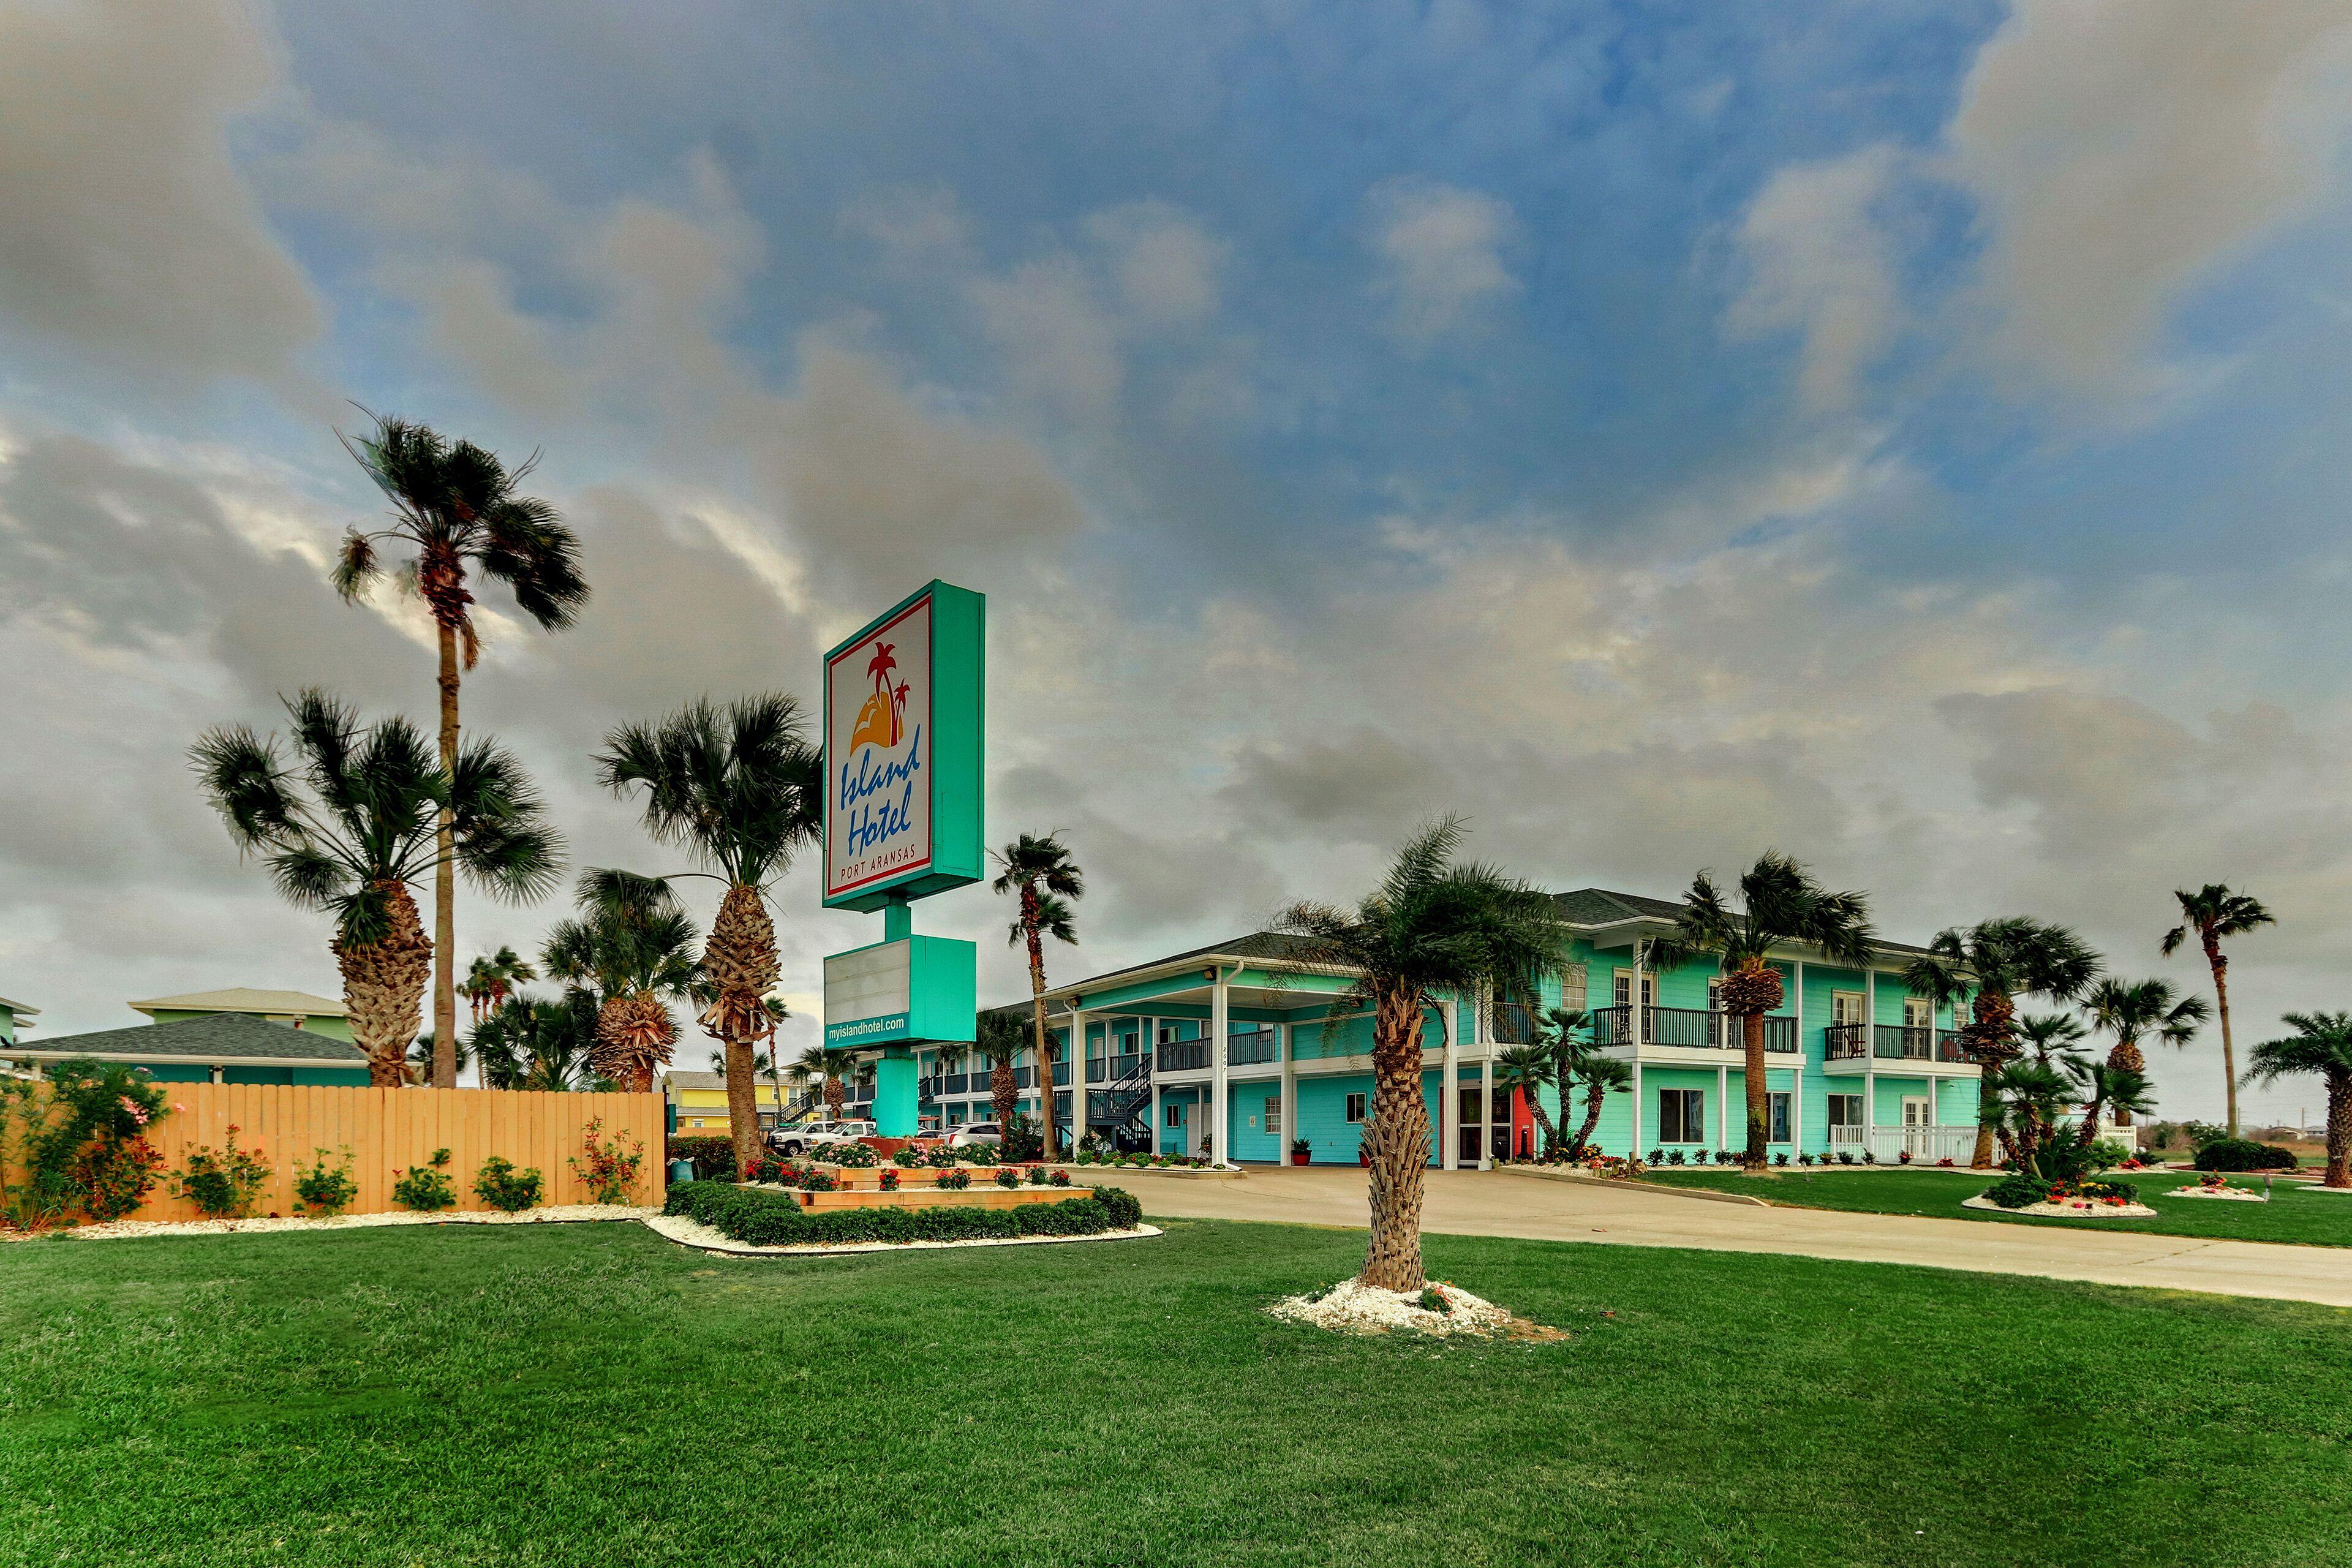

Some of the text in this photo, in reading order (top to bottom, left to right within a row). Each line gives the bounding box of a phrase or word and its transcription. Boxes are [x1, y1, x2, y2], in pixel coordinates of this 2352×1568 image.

[841, 723, 920, 810] Island
[848, 780, 912, 857] Hotel
[841, 844, 915, 881] PORT ARANSAS
[829, 1017, 904, 1041] myislandhotel.com
